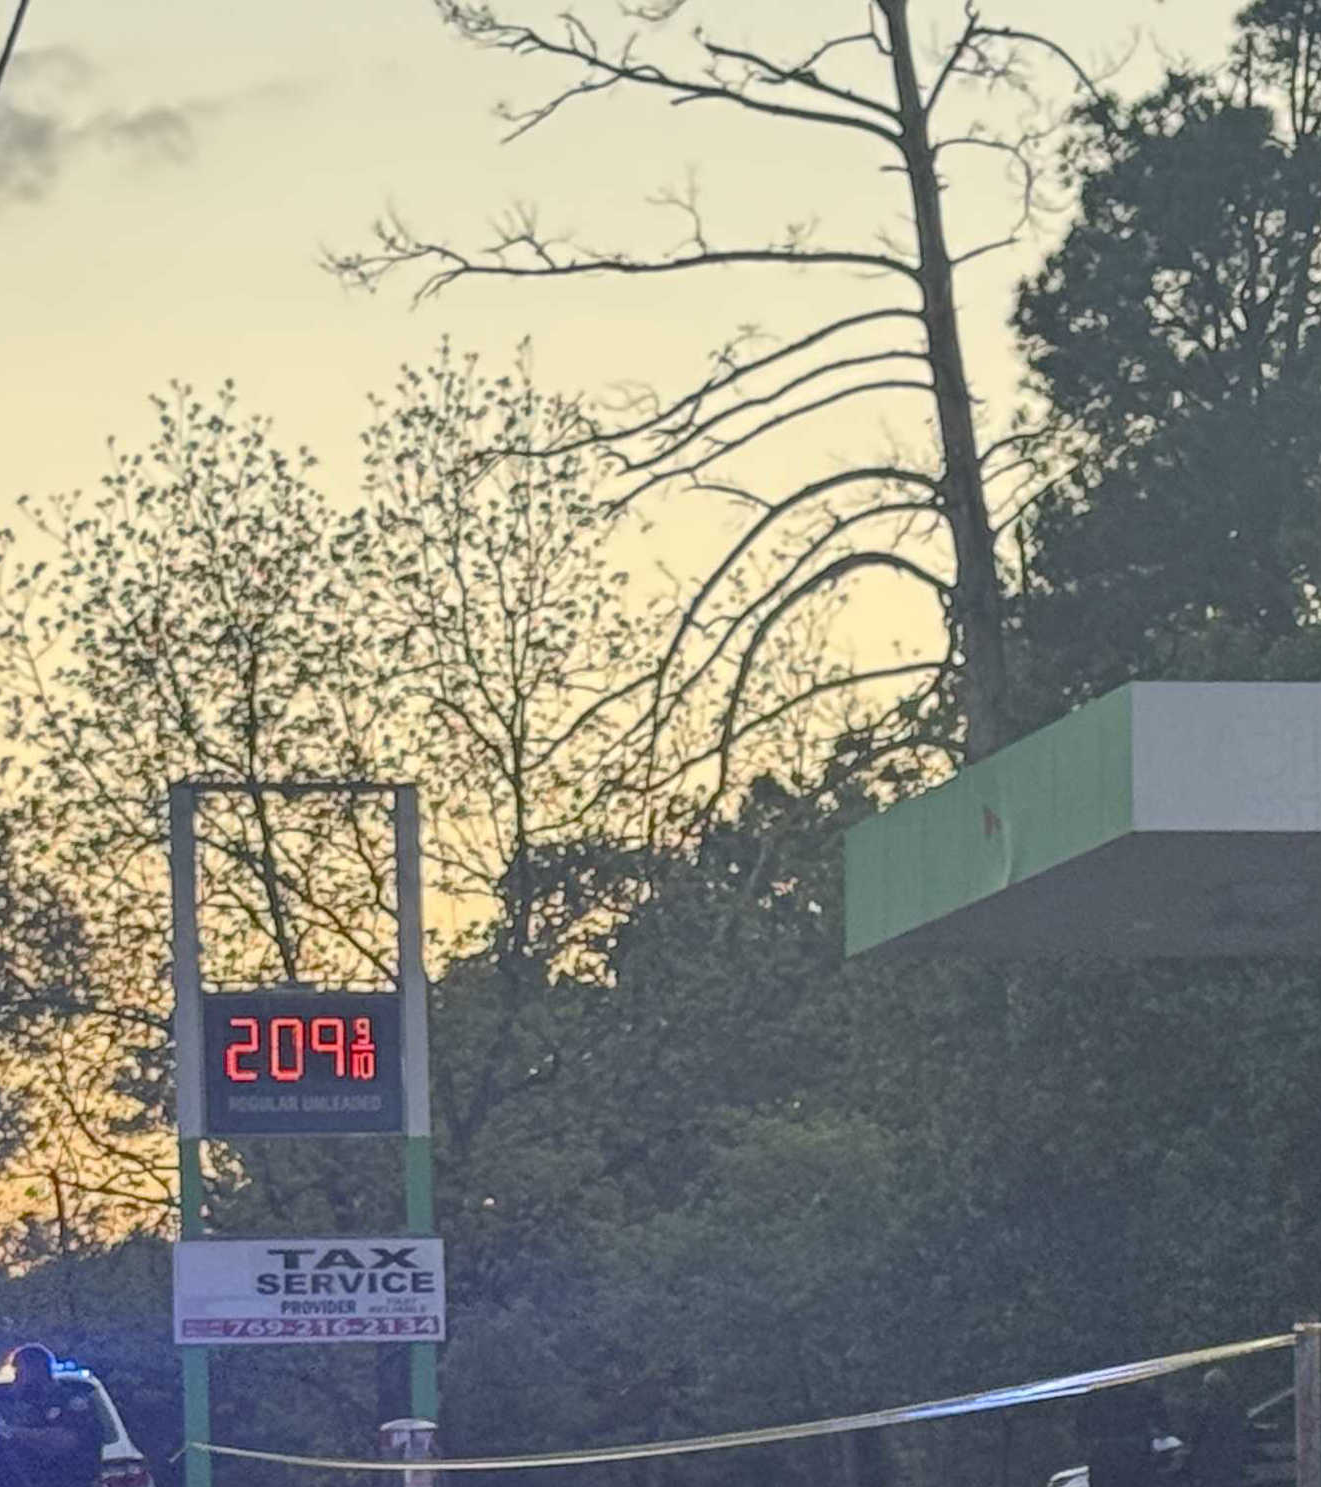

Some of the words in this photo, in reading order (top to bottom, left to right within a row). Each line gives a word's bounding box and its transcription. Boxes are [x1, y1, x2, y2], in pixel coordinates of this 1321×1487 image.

[225, 1016, 345, 1081] 209
[267, 1247, 419, 1270] TAX
[255, 1271, 436, 1295] SERVICE
[280, 1300, 357, 1315] PROVIDER
